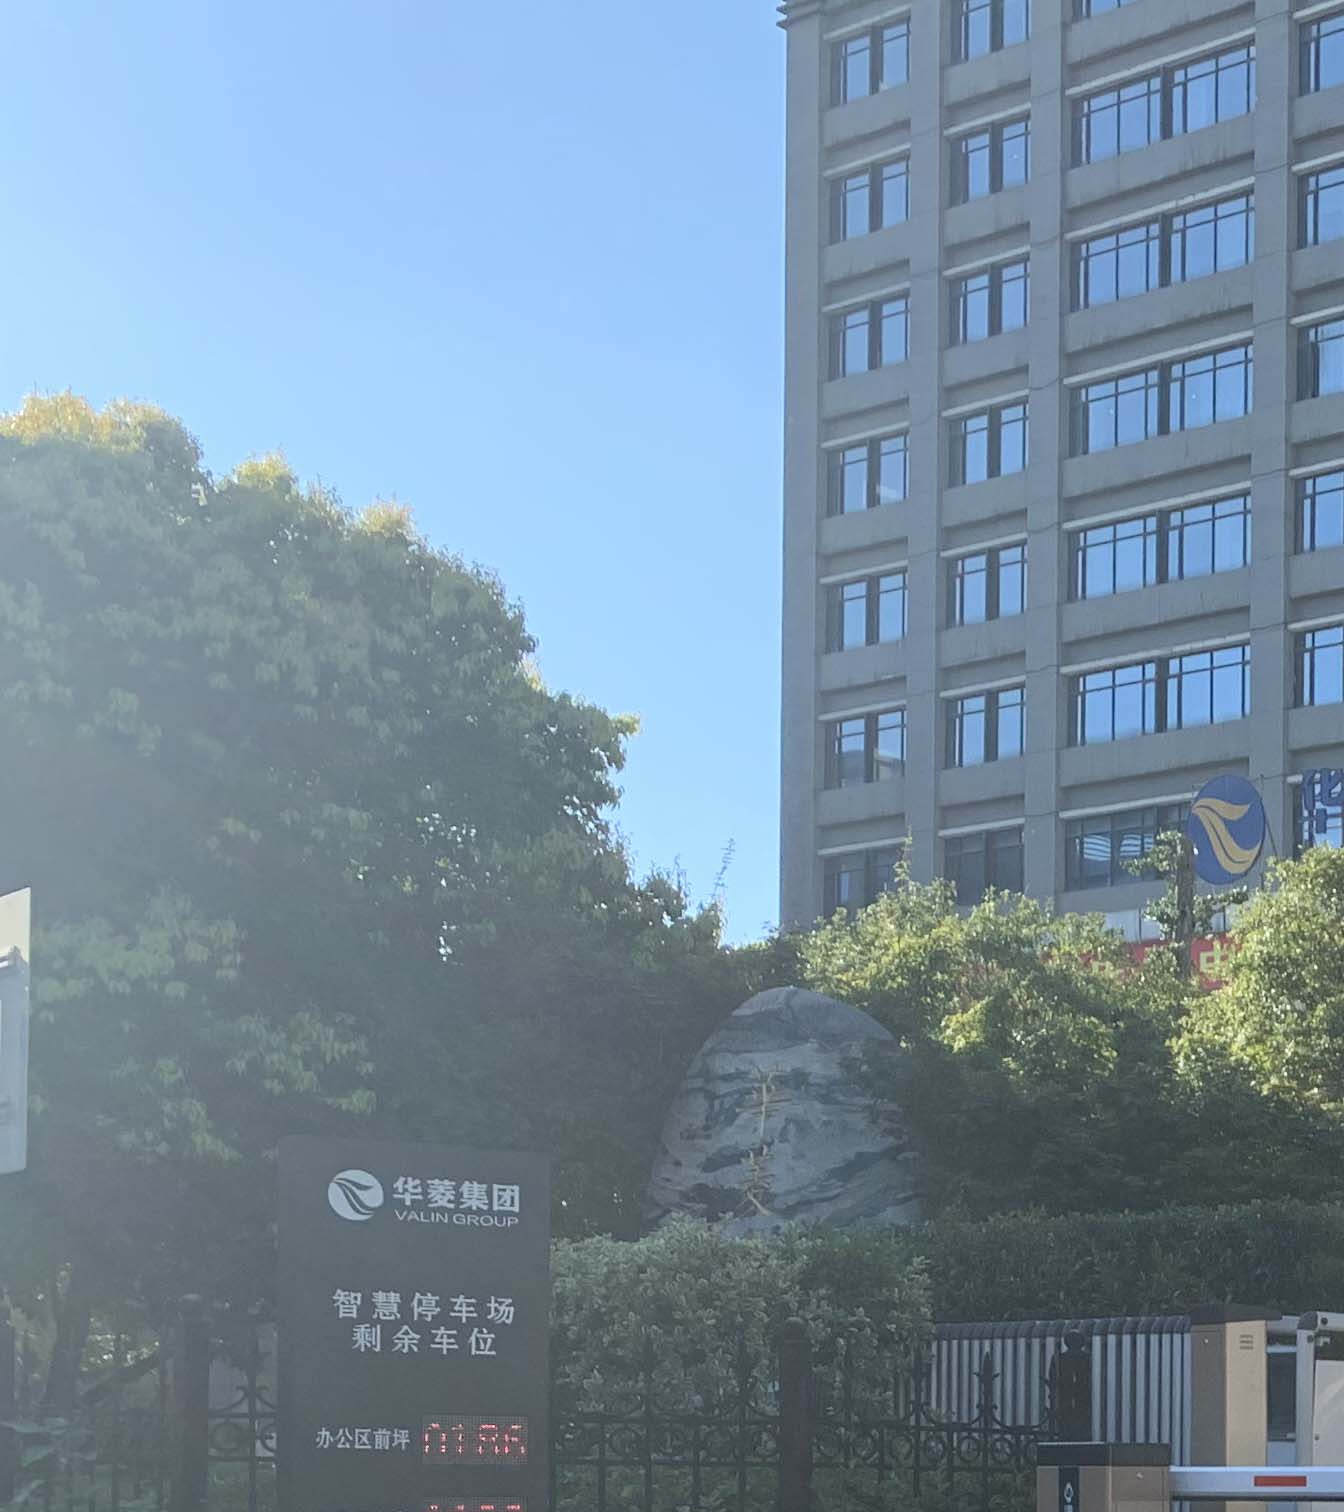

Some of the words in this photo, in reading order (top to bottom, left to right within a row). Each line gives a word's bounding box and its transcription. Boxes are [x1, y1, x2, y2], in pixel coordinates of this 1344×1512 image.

[393, 1176, 520, 1212] 华菱集团
[394, 1209, 449, 1224] VALIN
[453, 1213, 519, 1227] GROUP
[333, 1288, 515, 1324] 智慧停车场
[352, 1323, 496, 1355] 剩余车位
[315, 1427, 410, 1450] 办公区前坪
